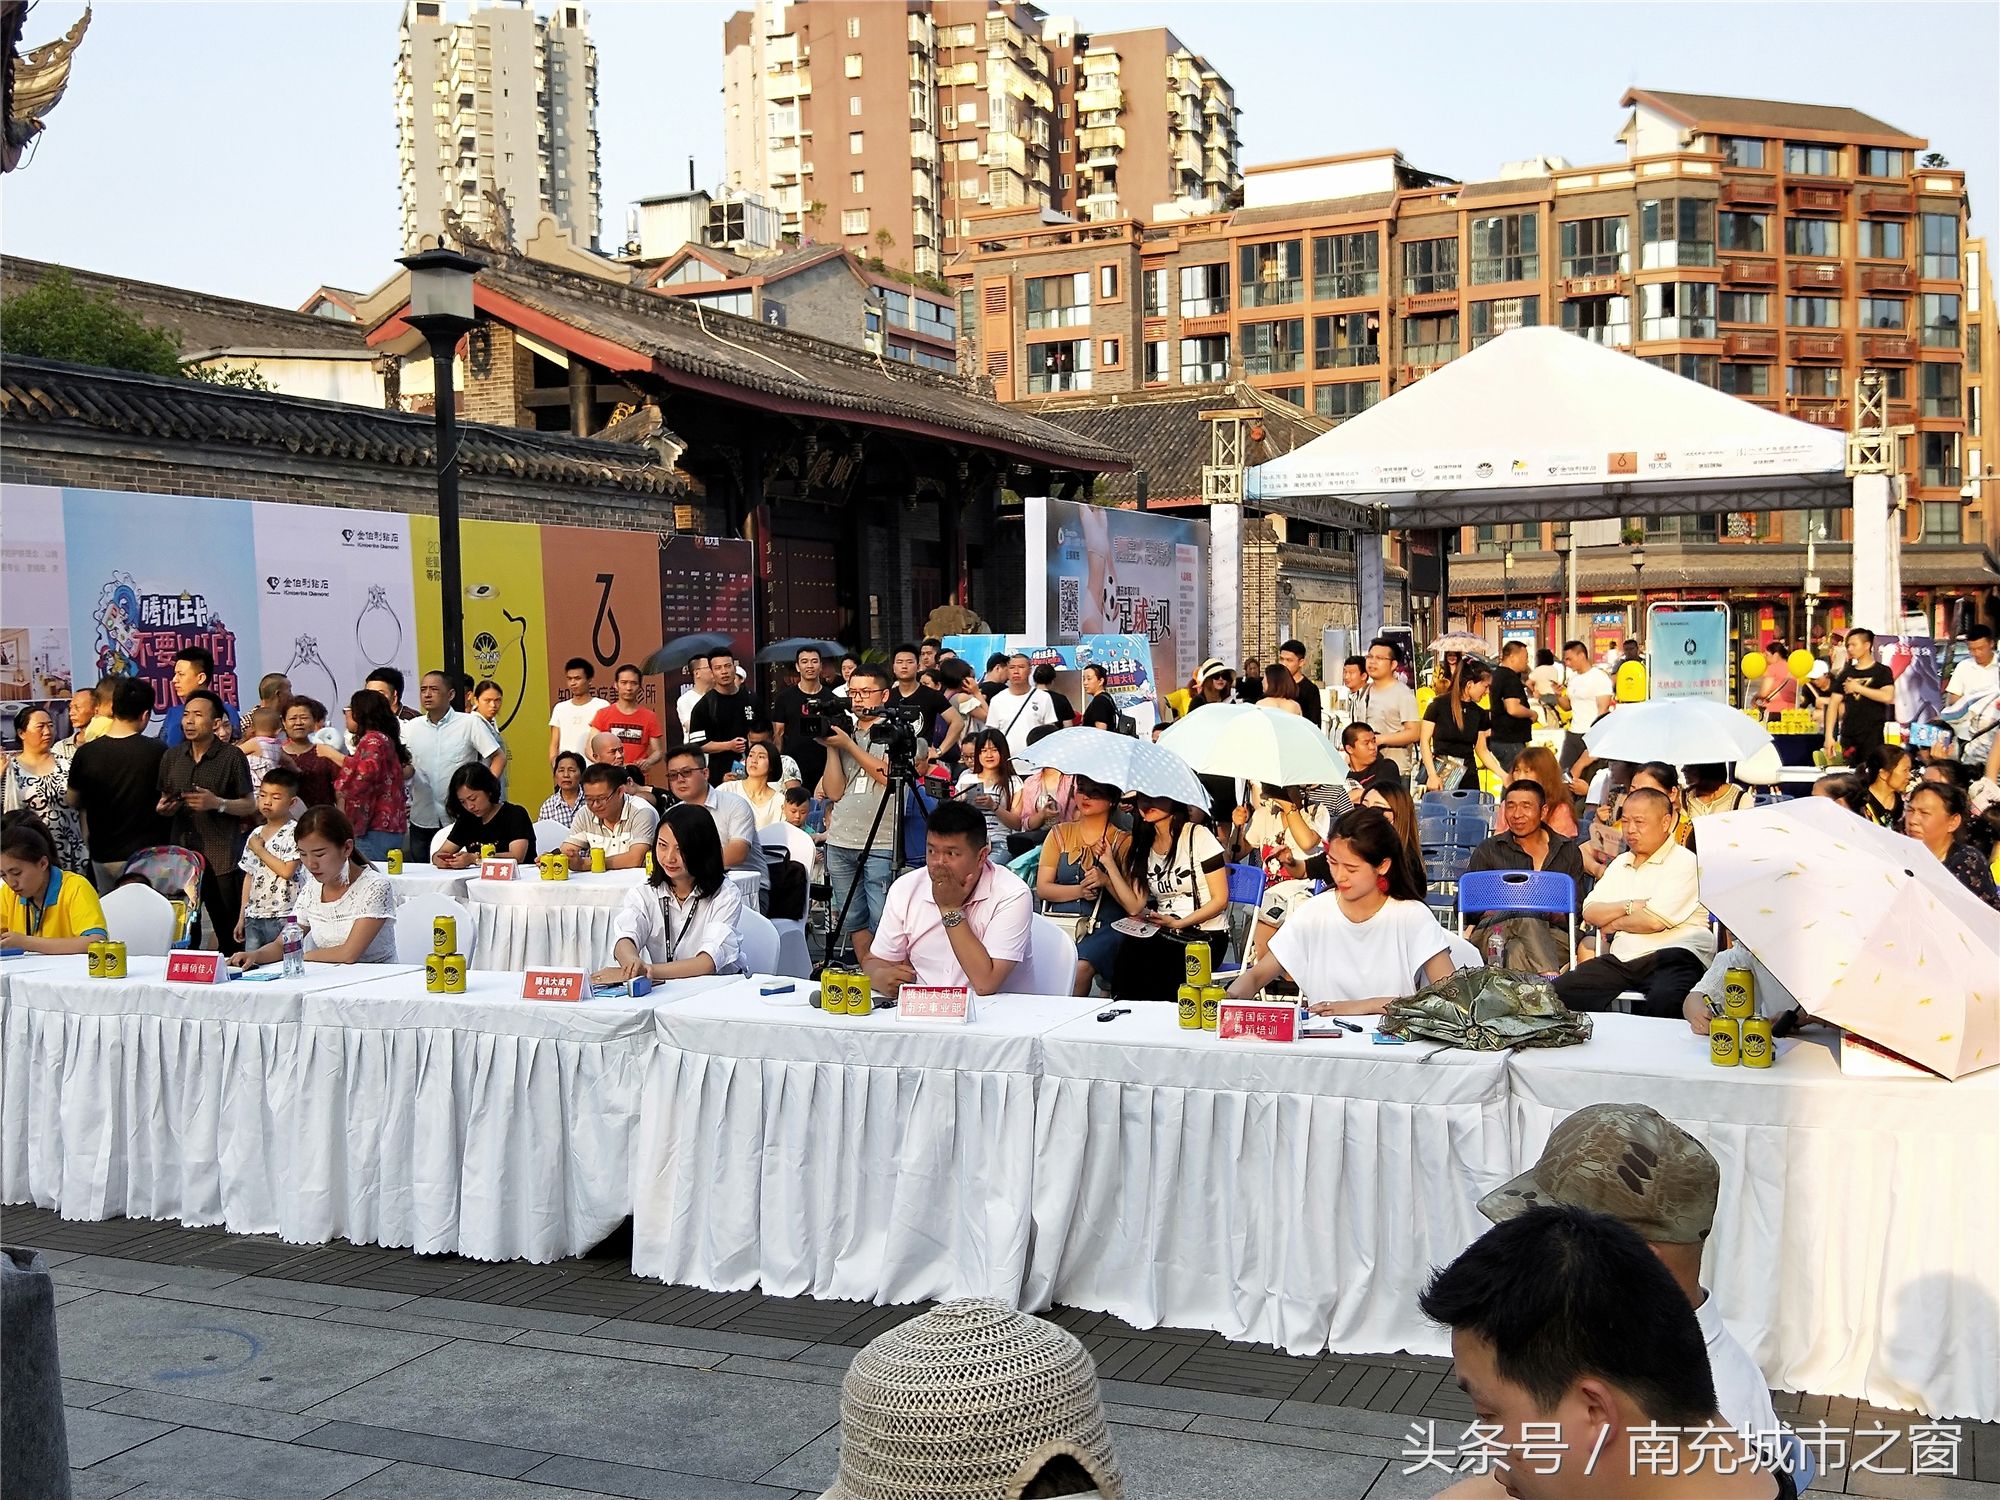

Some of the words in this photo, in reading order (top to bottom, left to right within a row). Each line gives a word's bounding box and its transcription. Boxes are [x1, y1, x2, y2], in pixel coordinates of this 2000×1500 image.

[357, 530, 399, 542] 金伯利钻石
[283, 577, 329, 589] 金伯利钻石
[141, 596, 208, 628] 腾讯王卡
[1116, 595, 1171, 645] 足球宝贝
[172, 962, 214, 974] 美丽俏佳人
[535, 976, 573, 987] 腾讯大成网
[537, 987, 568, 996] 企鹅南充
[905, 988, 962, 1000] 腾讯大成网
[905, 1001, 962, 1013] 南充事业部
[1234, 1023, 1278, 1036] 舞蹈培训
